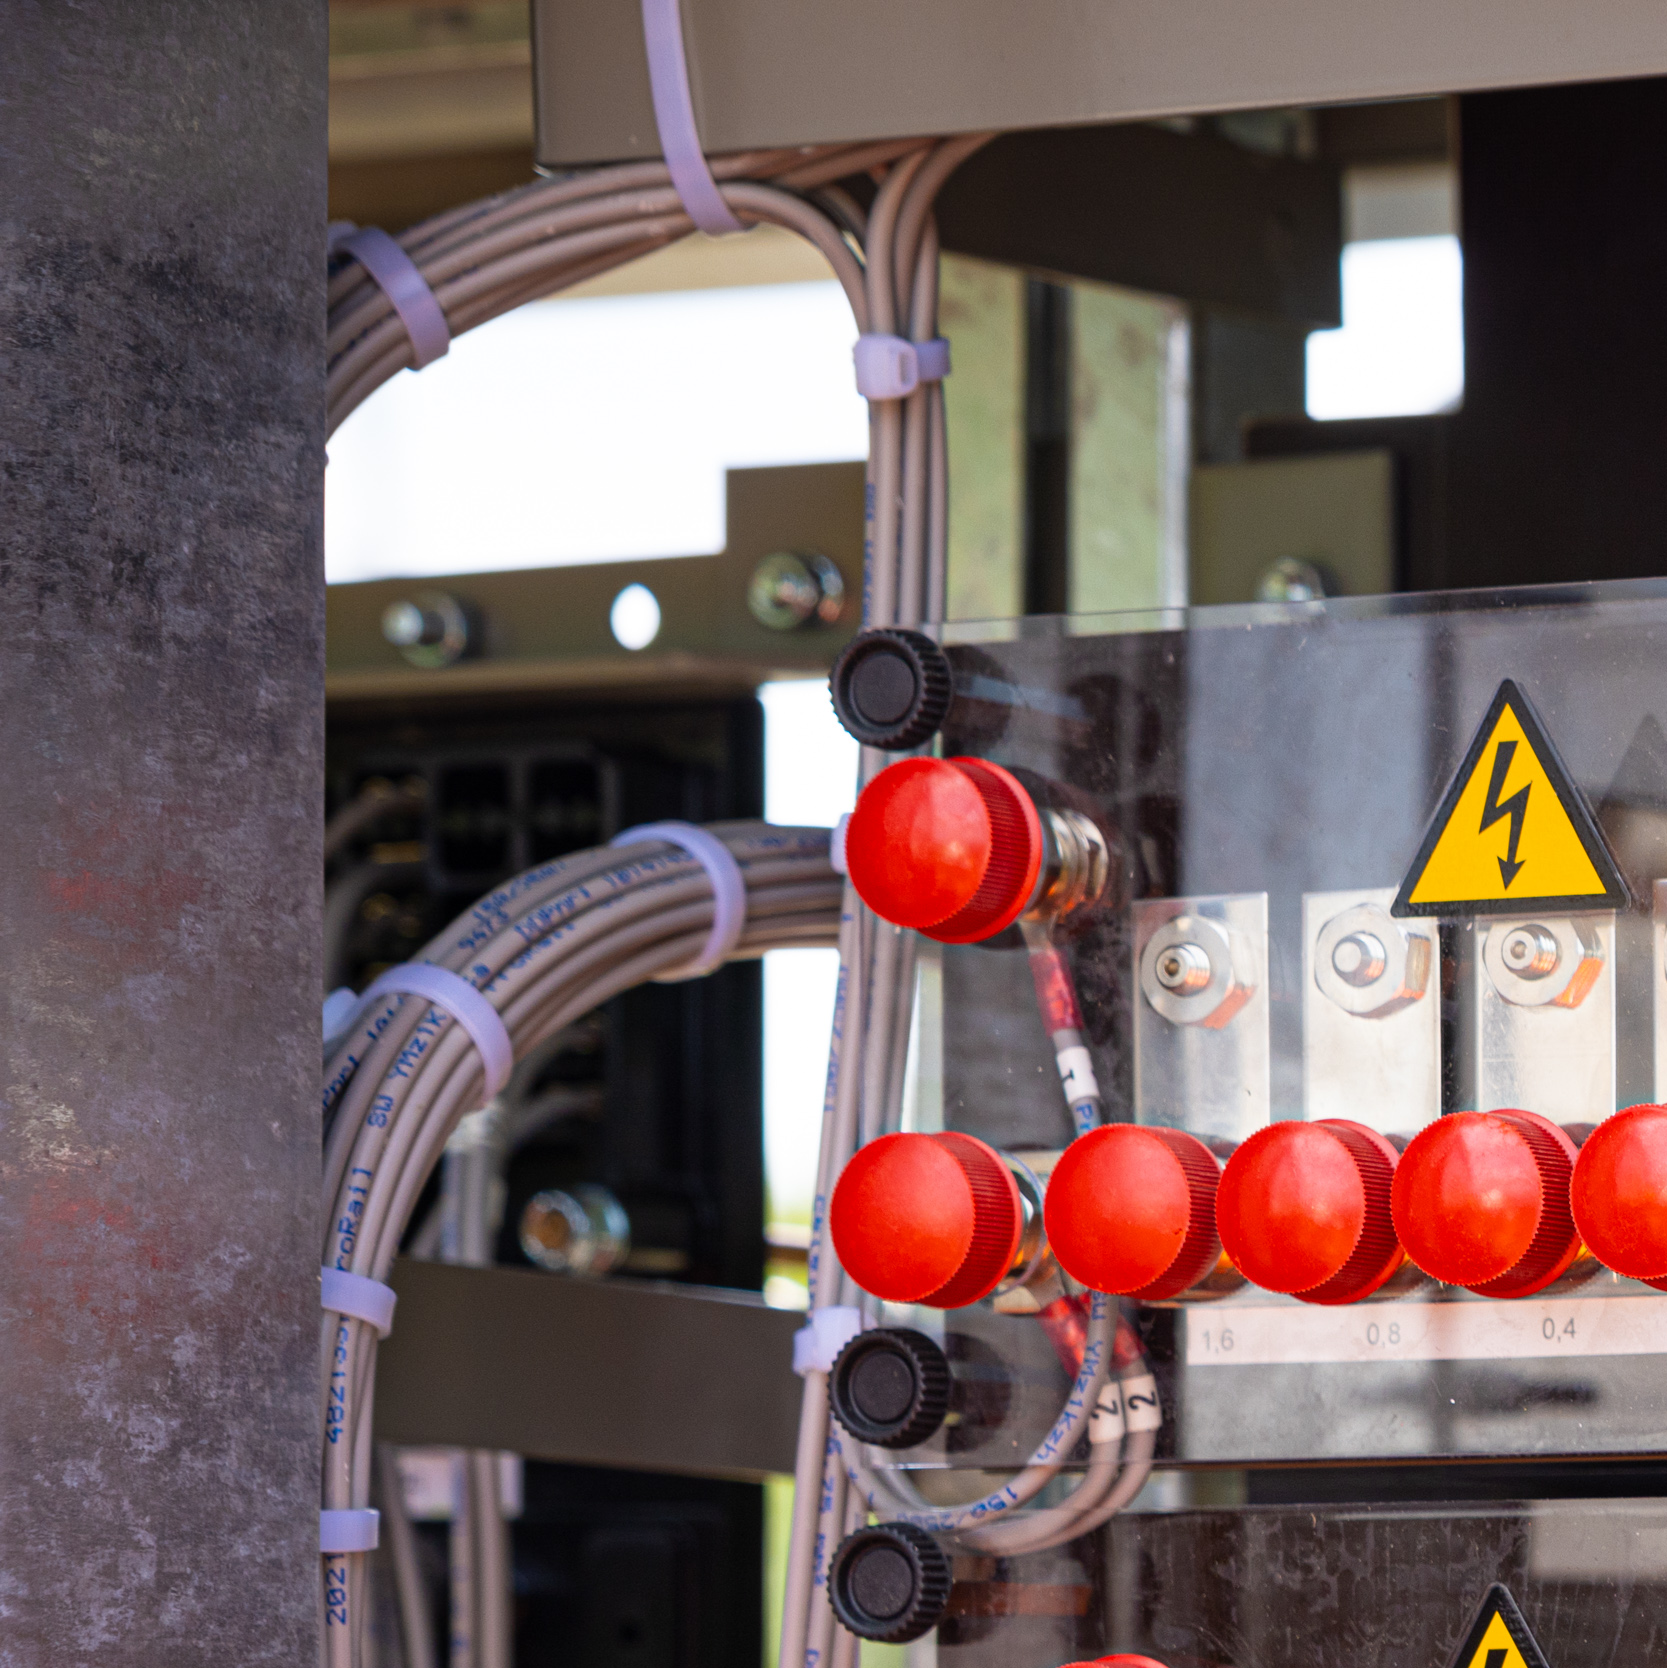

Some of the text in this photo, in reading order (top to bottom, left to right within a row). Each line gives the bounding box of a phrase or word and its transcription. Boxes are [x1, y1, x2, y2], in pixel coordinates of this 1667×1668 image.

[339, 1167, 372, 1269] roRail
[1366, 1322, 1402, 1349] 0,8
[1541, 1317, 1577, 1344] 0,4
[1129, 1390, 1157, 1411] 2
